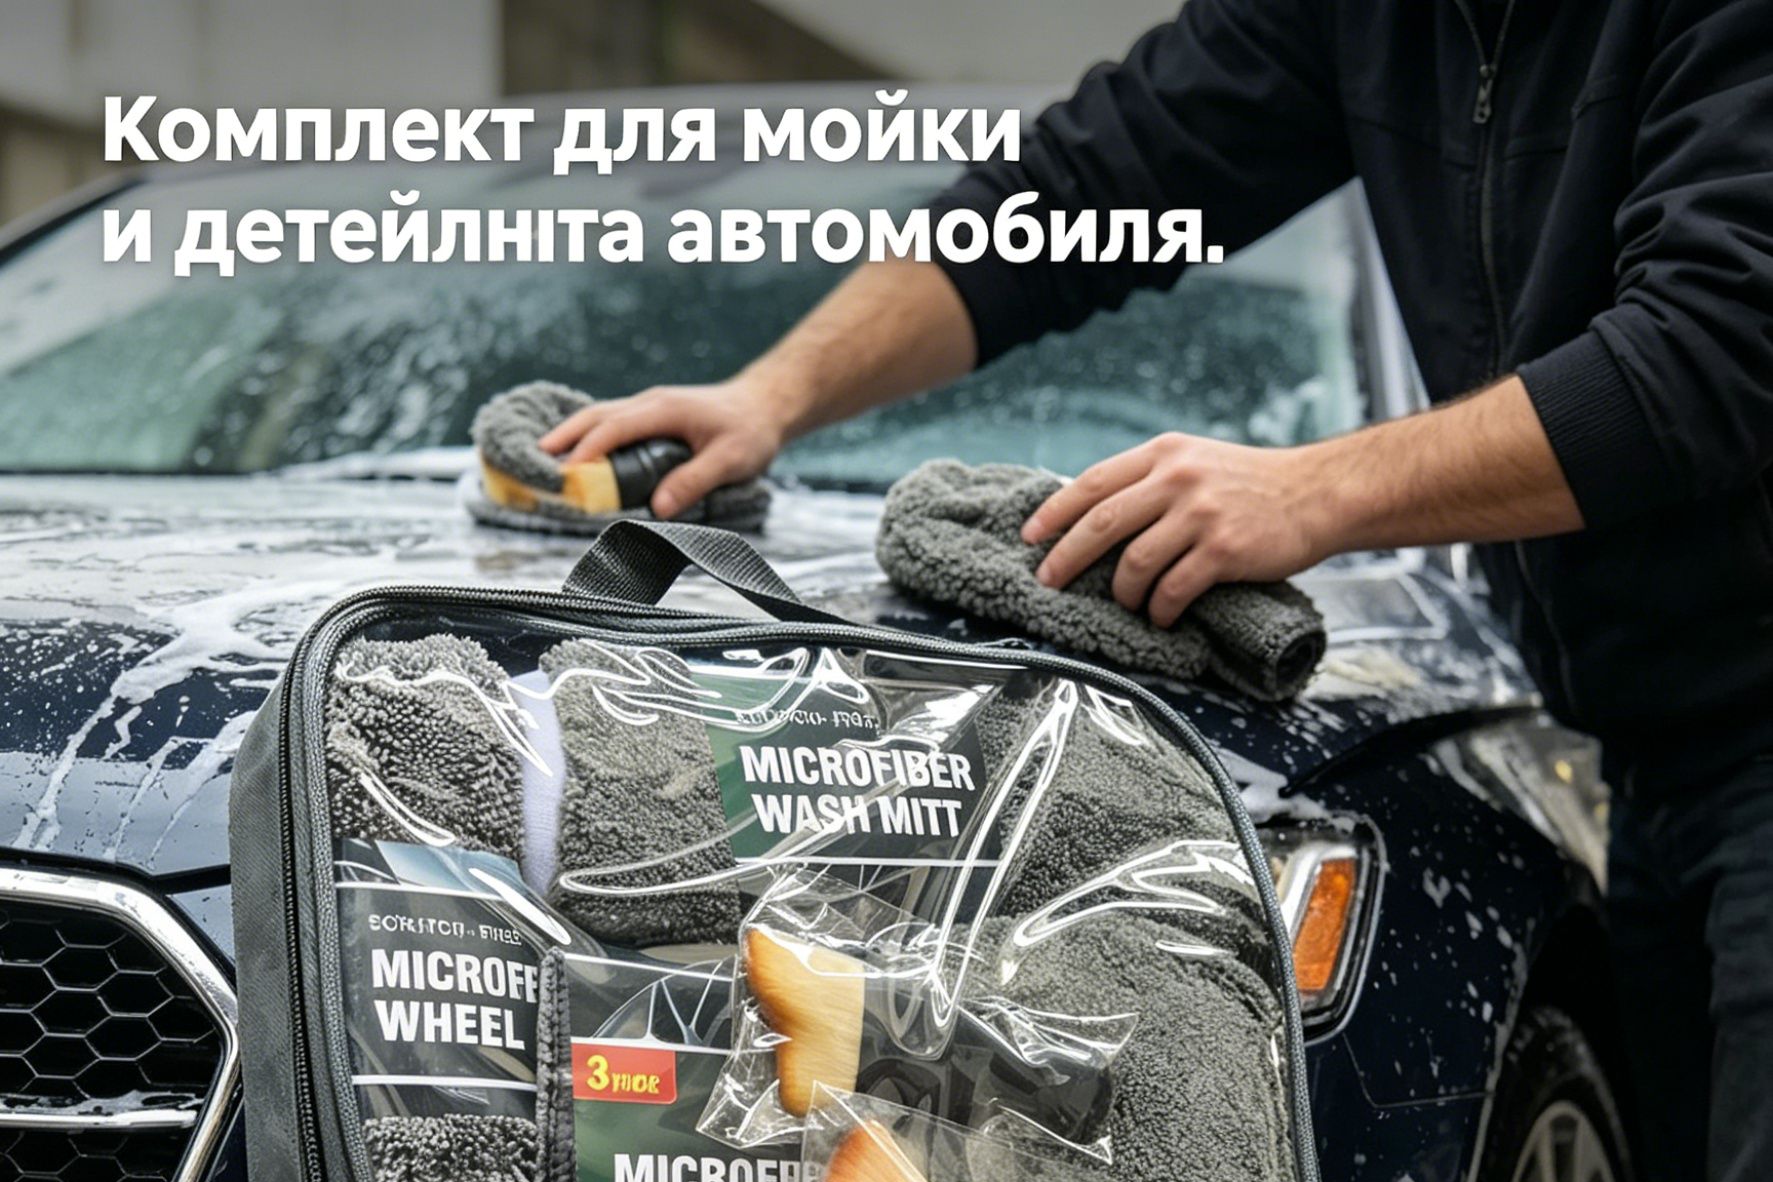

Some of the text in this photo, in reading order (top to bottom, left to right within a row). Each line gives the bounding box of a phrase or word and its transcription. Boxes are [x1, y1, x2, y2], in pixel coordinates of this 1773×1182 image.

[739, 745, 975, 791] MICROFIBER
[752, 794, 962, 837] WASH MITT
[374, 1000, 526, 1050] WHEEL
[586, 1055, 609, 1091] 3
